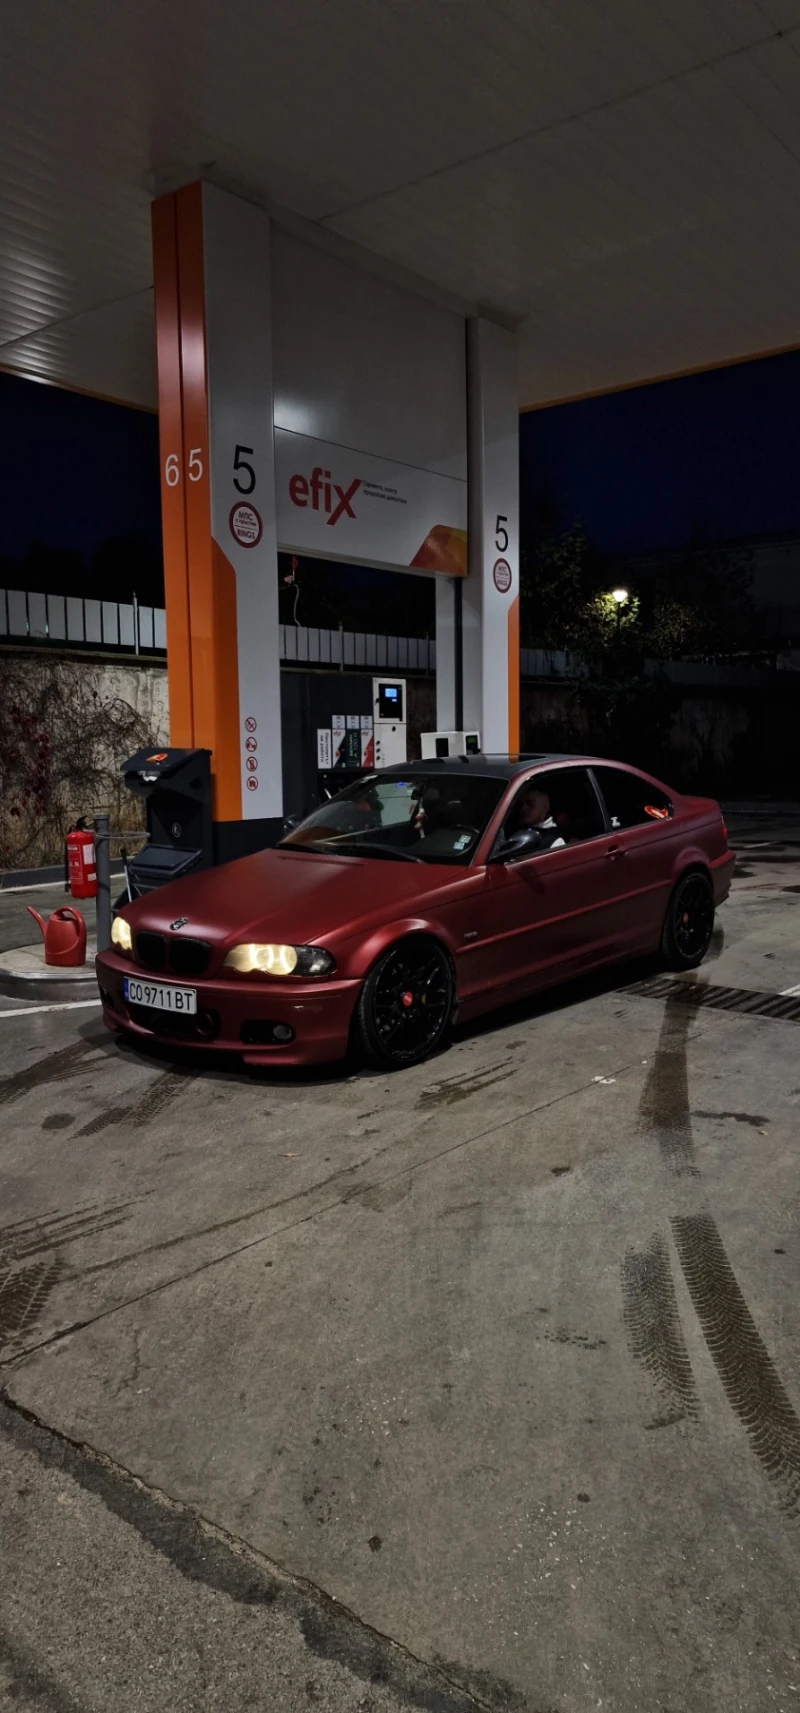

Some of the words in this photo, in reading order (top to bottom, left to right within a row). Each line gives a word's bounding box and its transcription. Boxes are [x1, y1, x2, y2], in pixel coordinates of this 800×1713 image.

[165, 454, 180, 487] 6
[188, 448, 203, 481] 5
[233, 444, 256, 495] 5
[288, 467, 363, 526] efix
[237, 529, 256, 539] RINGS
[495, 514, 509, 552] 5
[130, 982, 143, 1001] CO
[144, 986, 171, 1008] 9711
[175, 991, 193, 1011] BT
